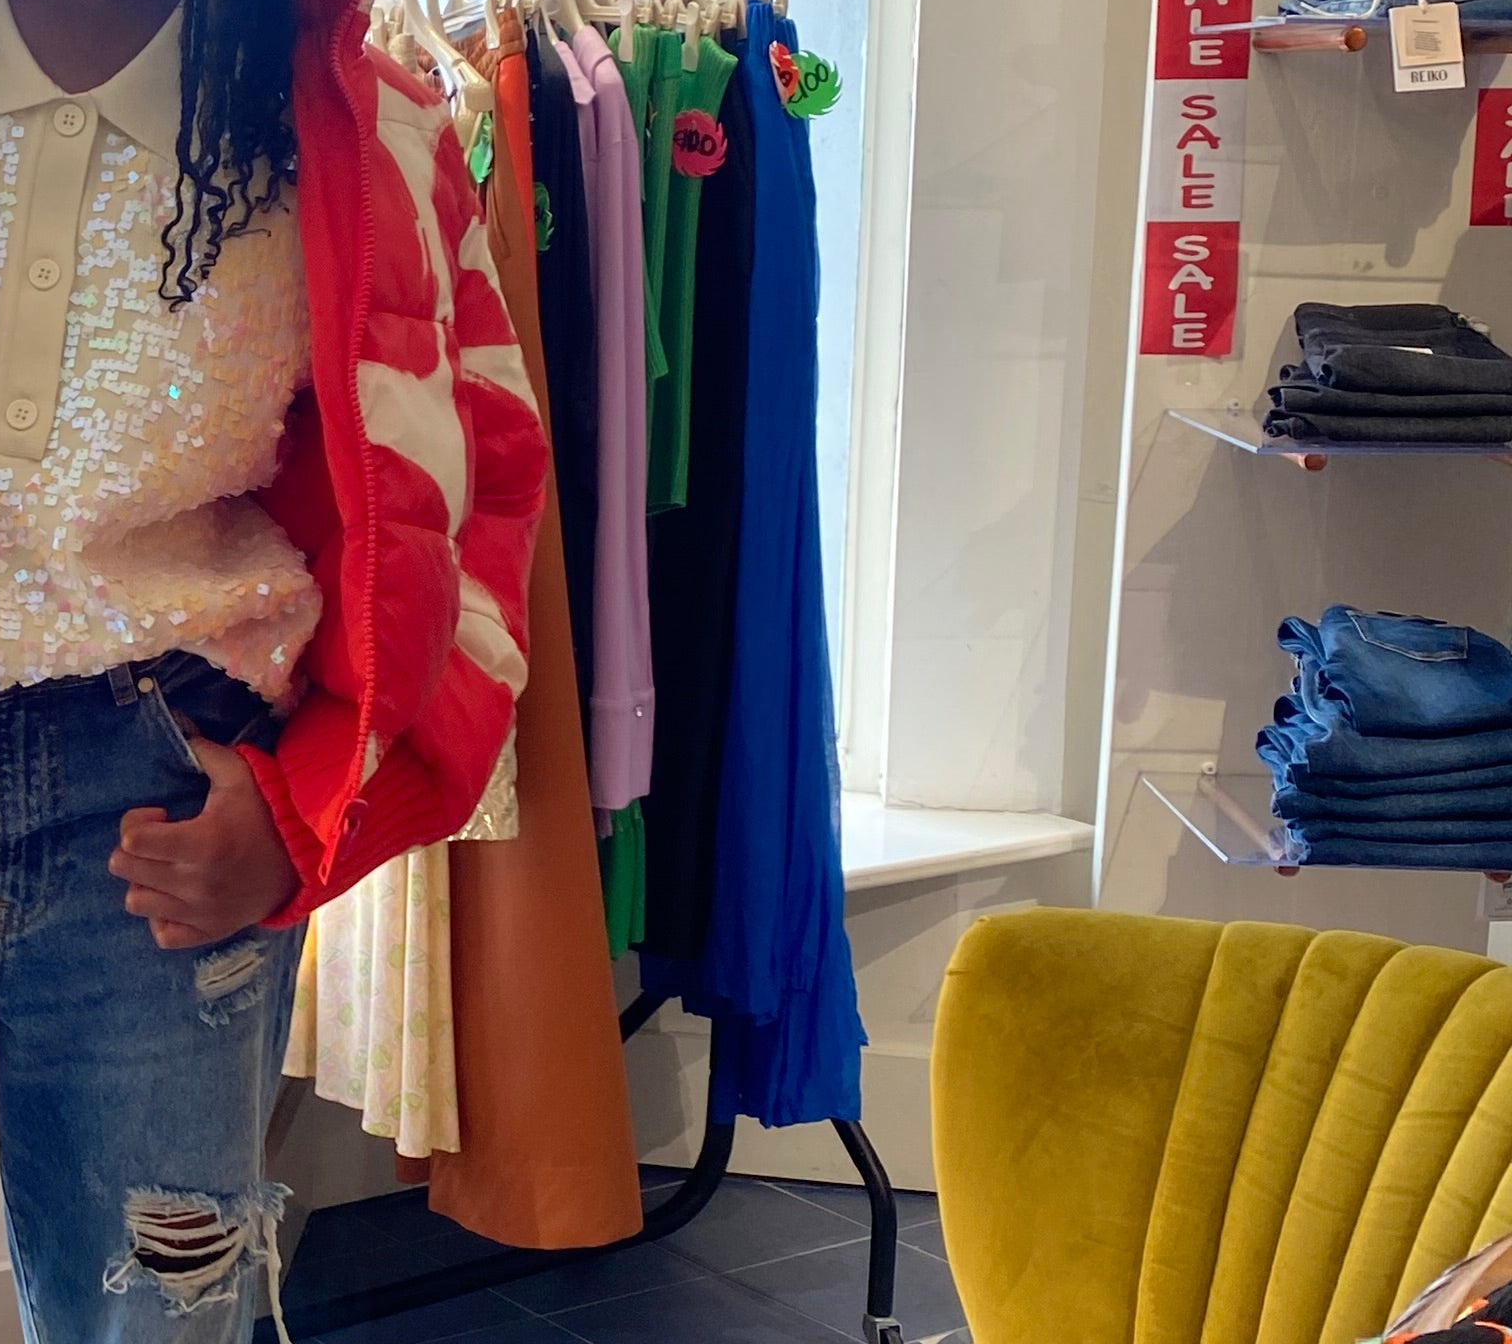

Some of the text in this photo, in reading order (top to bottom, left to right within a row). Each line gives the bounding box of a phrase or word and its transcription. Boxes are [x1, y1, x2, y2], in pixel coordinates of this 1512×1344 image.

[1410, 69, 1448, 83] REIKO
[1176, 94, 1222, 209] SALE
[1168, 234, 1215, 349] SALE
